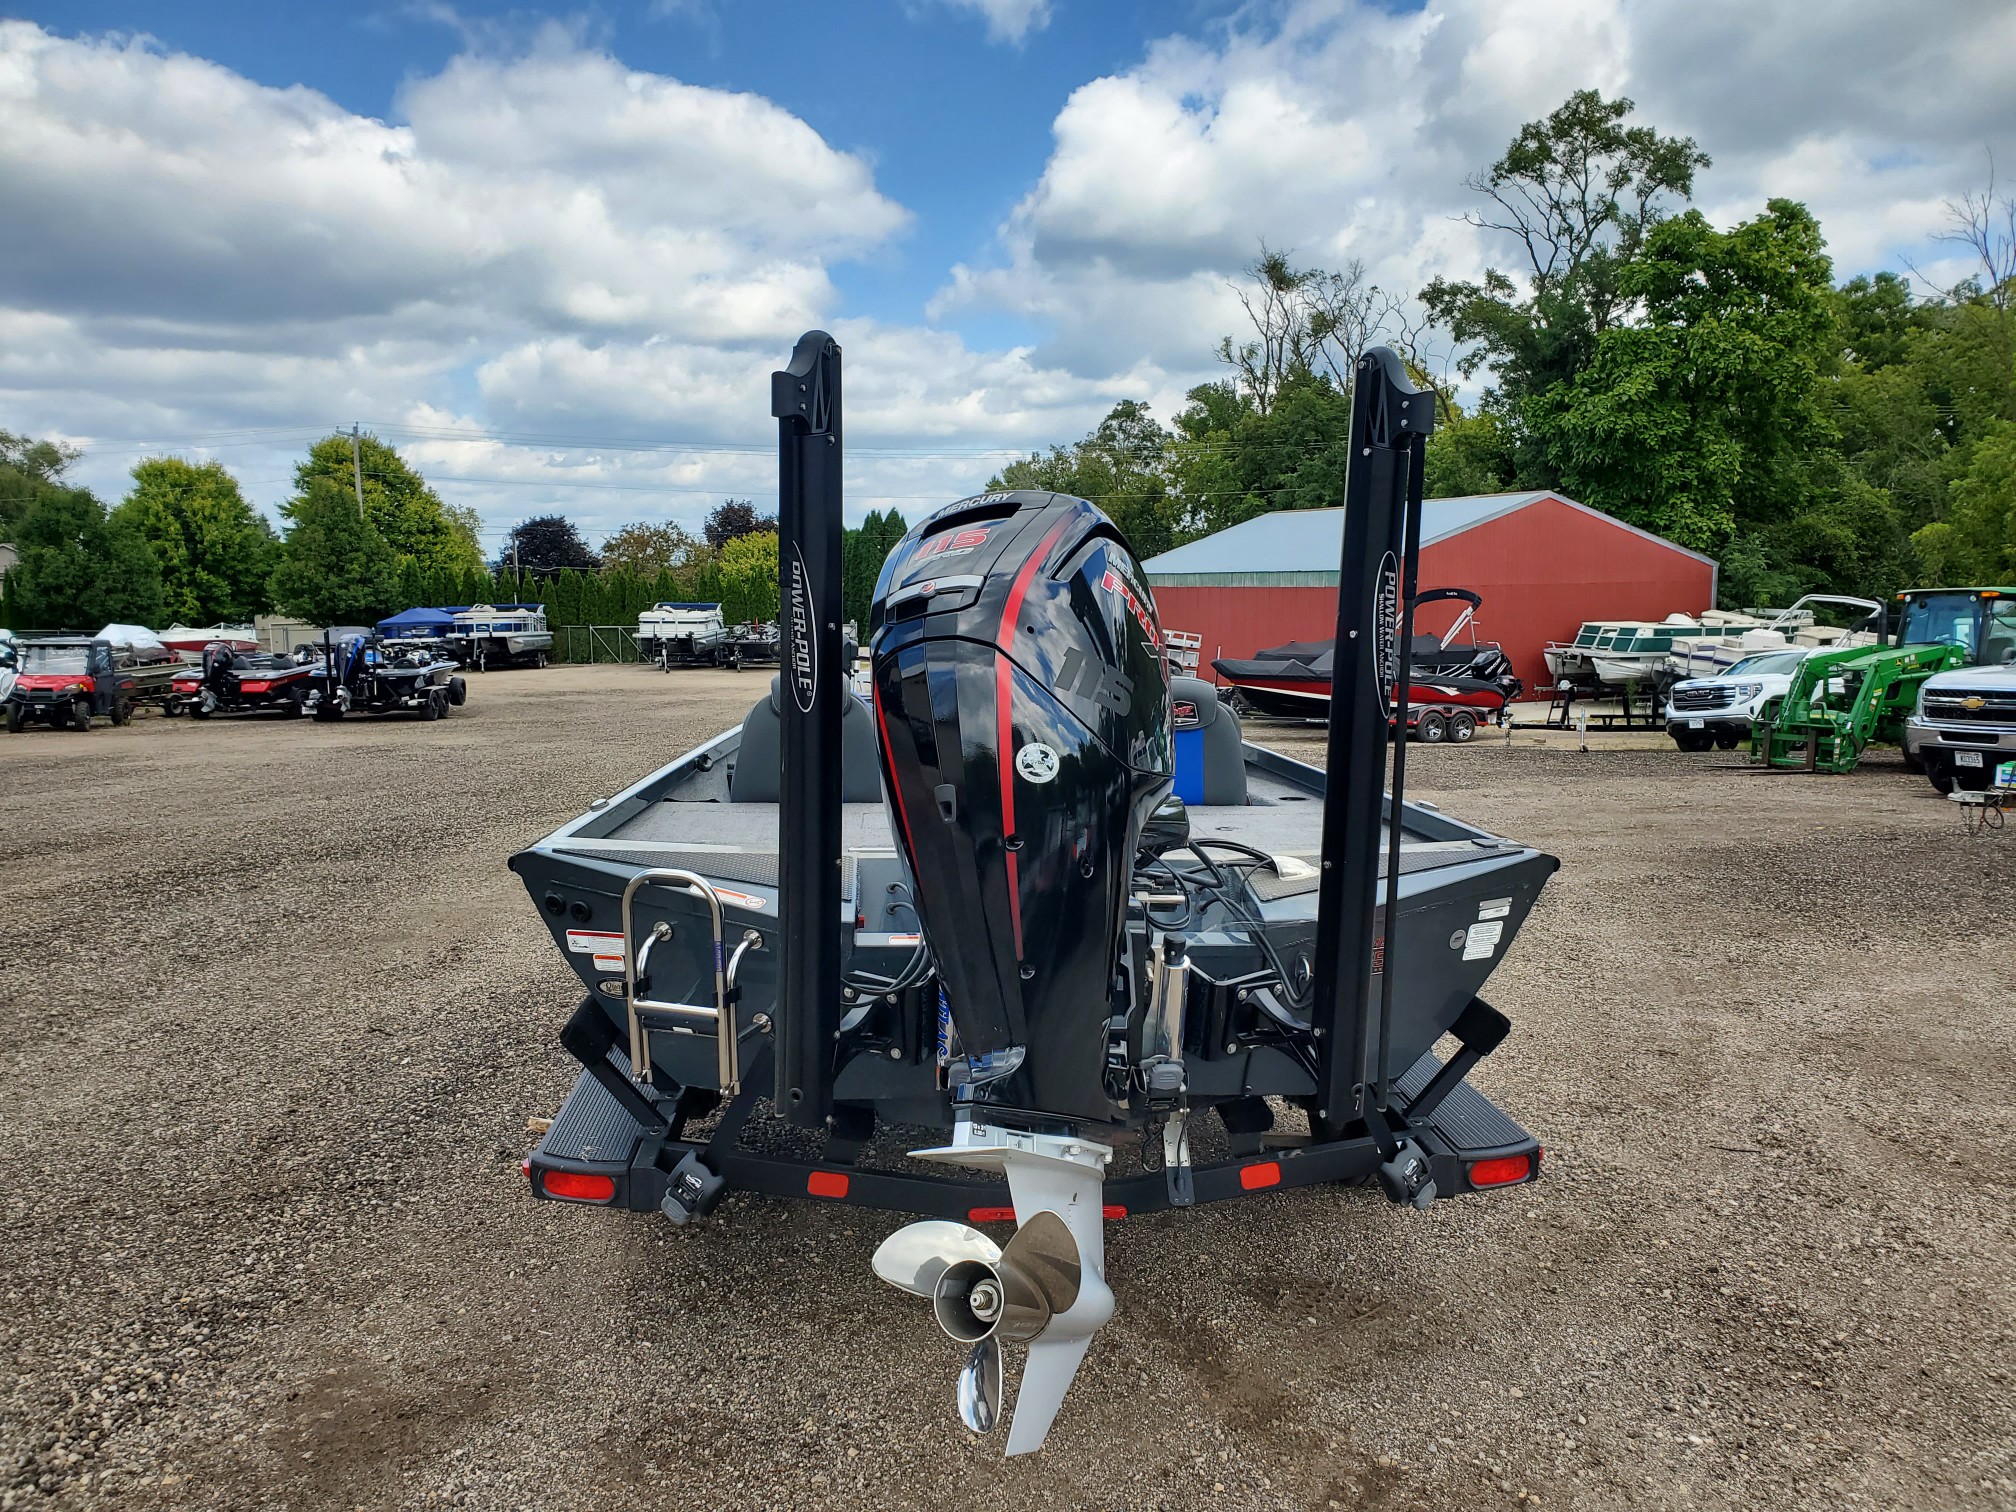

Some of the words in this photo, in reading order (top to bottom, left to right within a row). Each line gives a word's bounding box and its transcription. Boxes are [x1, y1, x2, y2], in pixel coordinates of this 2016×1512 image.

[937, 492, 1015, 519] MERCURY
[915, 528, 990, 560] 115
[1101, 570, 1160, 651] PRO
[1107, 551, 1154, 614] MERCURY
[791, 560, 813, 690] POWER-POLE
[1384, 570, 1396, 697] POWER-POLE
[1053, 646, 1135, 717] 115
